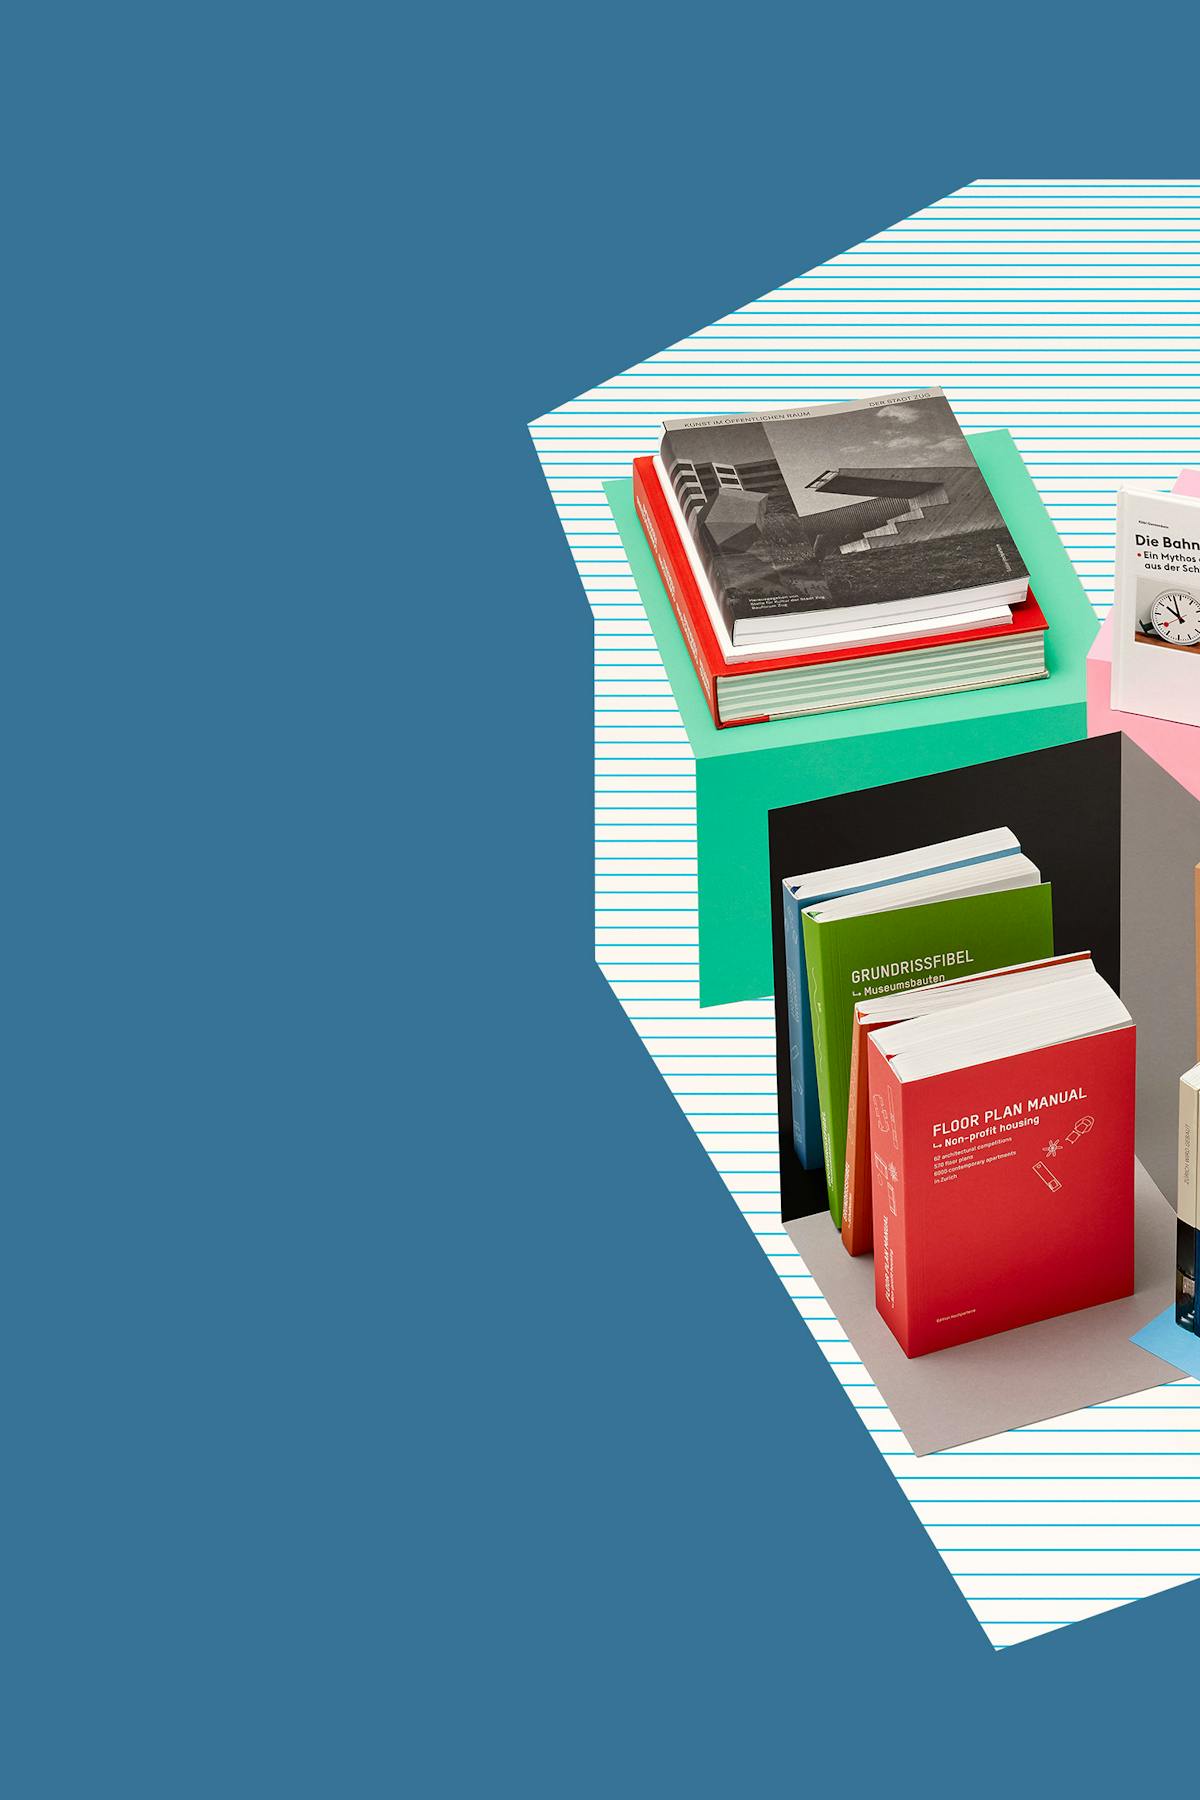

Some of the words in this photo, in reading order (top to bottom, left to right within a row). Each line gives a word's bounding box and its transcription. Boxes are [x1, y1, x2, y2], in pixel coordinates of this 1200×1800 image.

[684, 419, 711, 428] KUNST
[1135, 534, 1159, 547] Die
[1143, 551, 1159, 560] Ein
[1161, 552, 1197, 563] Mythos
[1163, 563, 1180, 572] der
[851, 949, 974, 984] GRUNDRISSFIBEL
[864, 974, 945, 996] Museumsbauten
[933, 1115, 979, 1137] FLOOR
[985, 1103, 1023, 1123] PLAN
[1027, 1087, 1087, 1112] MANUAL
[944, 1126, 997, 1147] Non-profit
[1000, 1116, 1039, 1134] housing
[942, 1145, 977, 1160] architectural
[977, 1137, 1012, 1150] competitions
[948, 1159, 985, 1173] contemporary
[986, 1151, 1017, 1163] apartments
[958, 1155, 973, 1164] plans
[940, 1174, 958, 1183] Zurich
